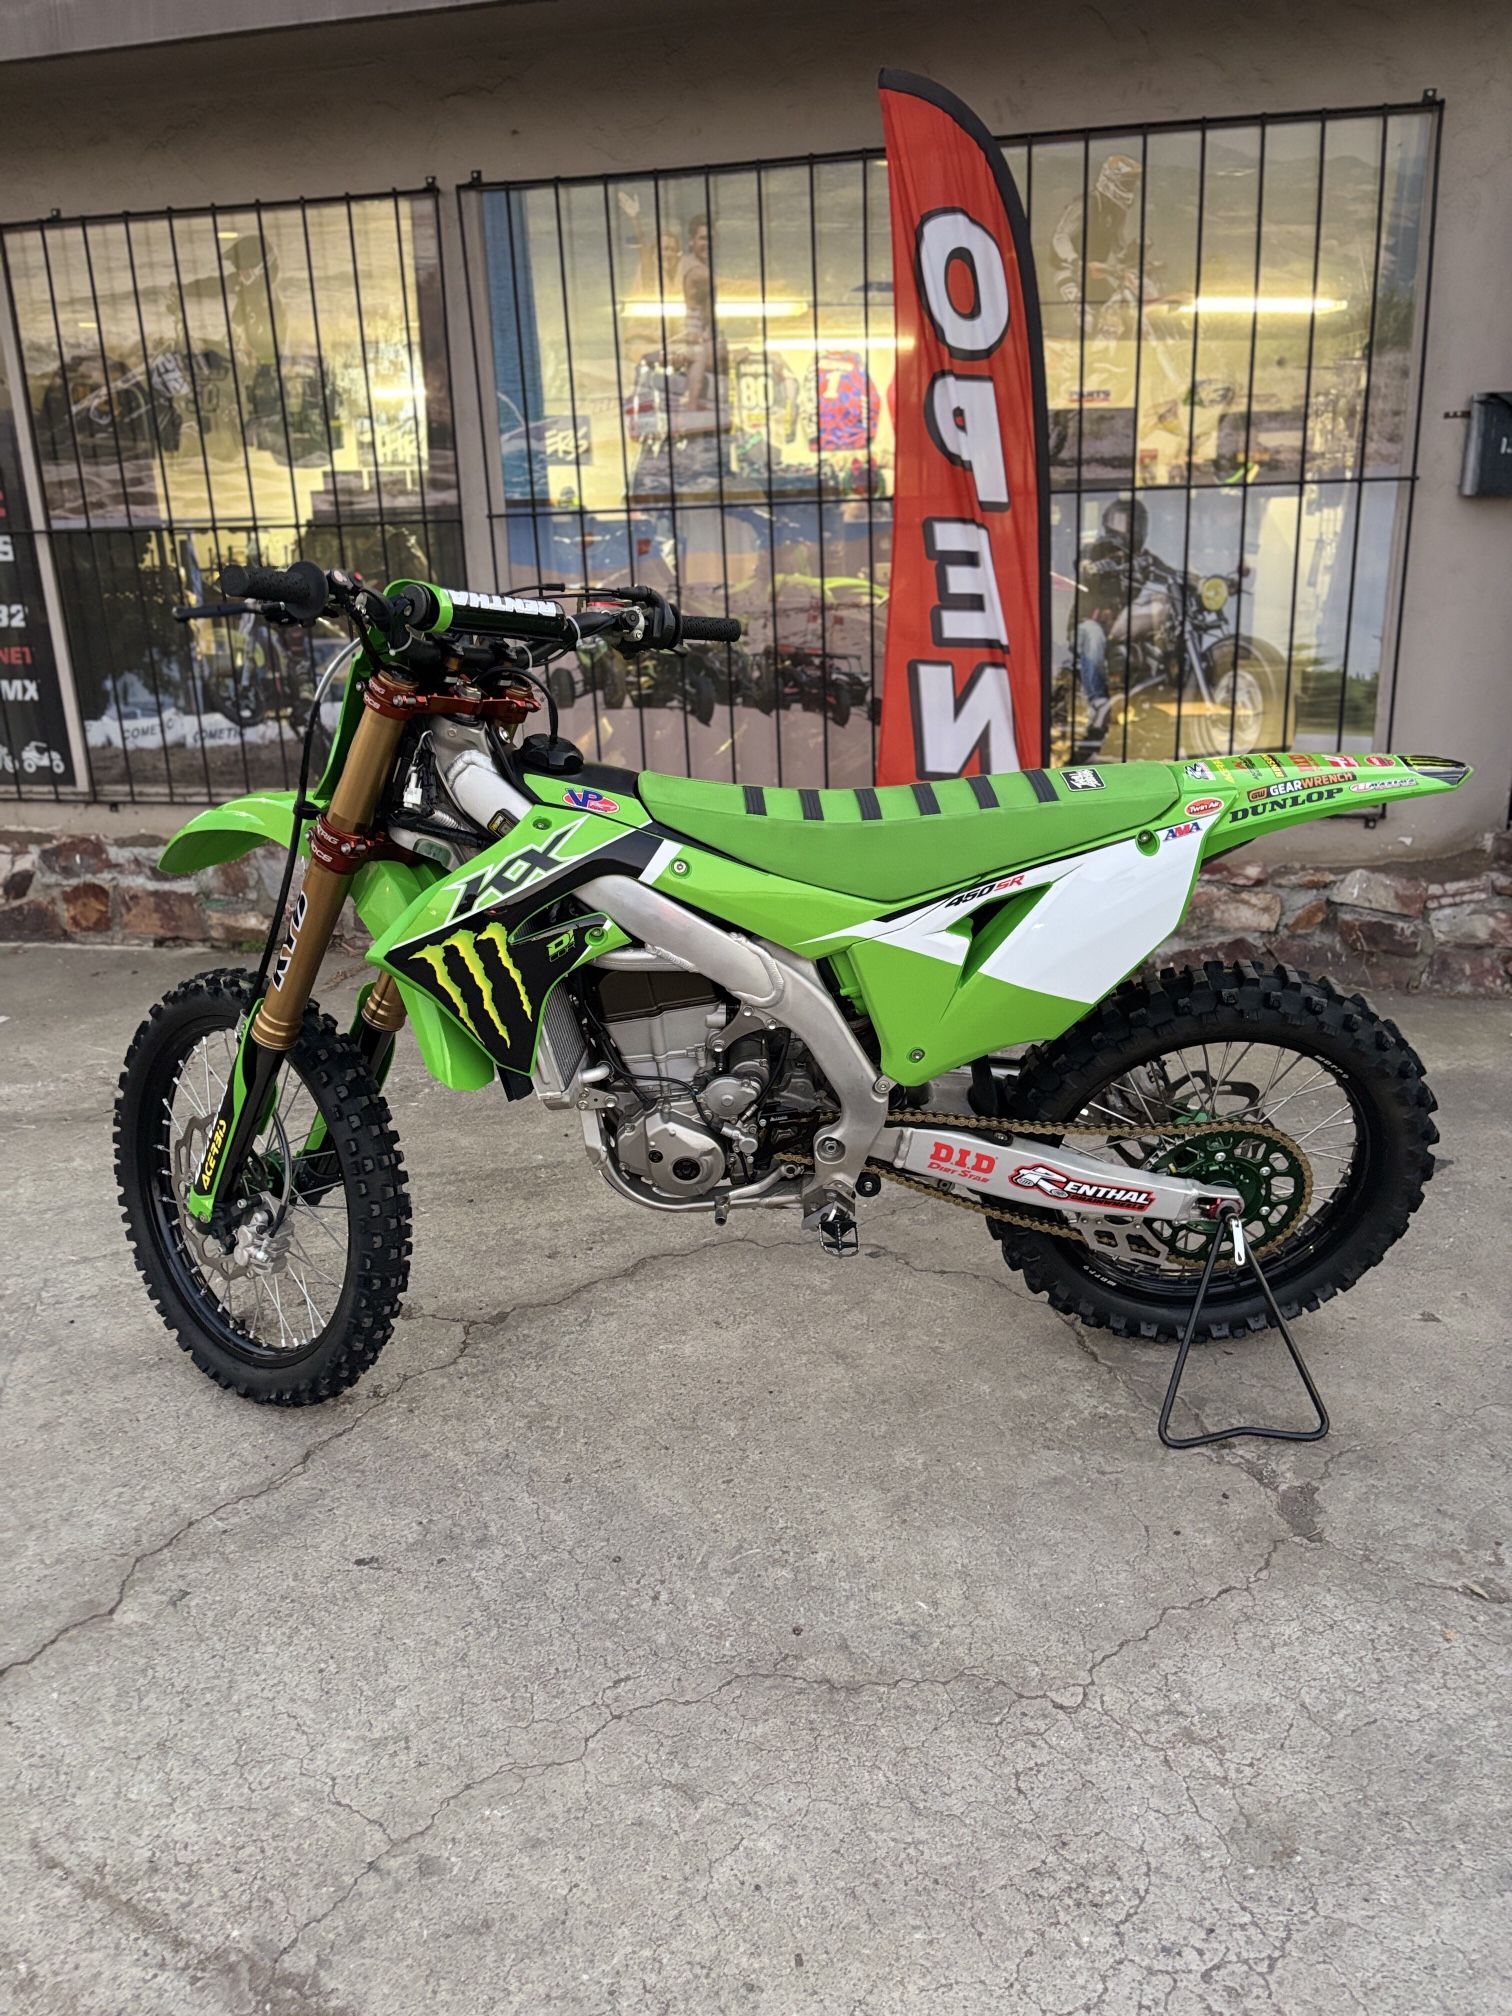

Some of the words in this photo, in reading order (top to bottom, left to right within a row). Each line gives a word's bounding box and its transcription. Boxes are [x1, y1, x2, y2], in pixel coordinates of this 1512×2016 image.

[1269, 772, 1354, 796] GEARWRENCH
[565, 787, 604, 809] VP
[1189, 804, 1208, 813] Twin
[1208, 801, 1220, 809] Air
[1229, 788, 1343, 823] DUNLOP
[1164, 822, 1200, 840] AMA
[945, 874, 1025, 908] 450SR
[1013, 1166, 1151, 1205] RENTHAL
